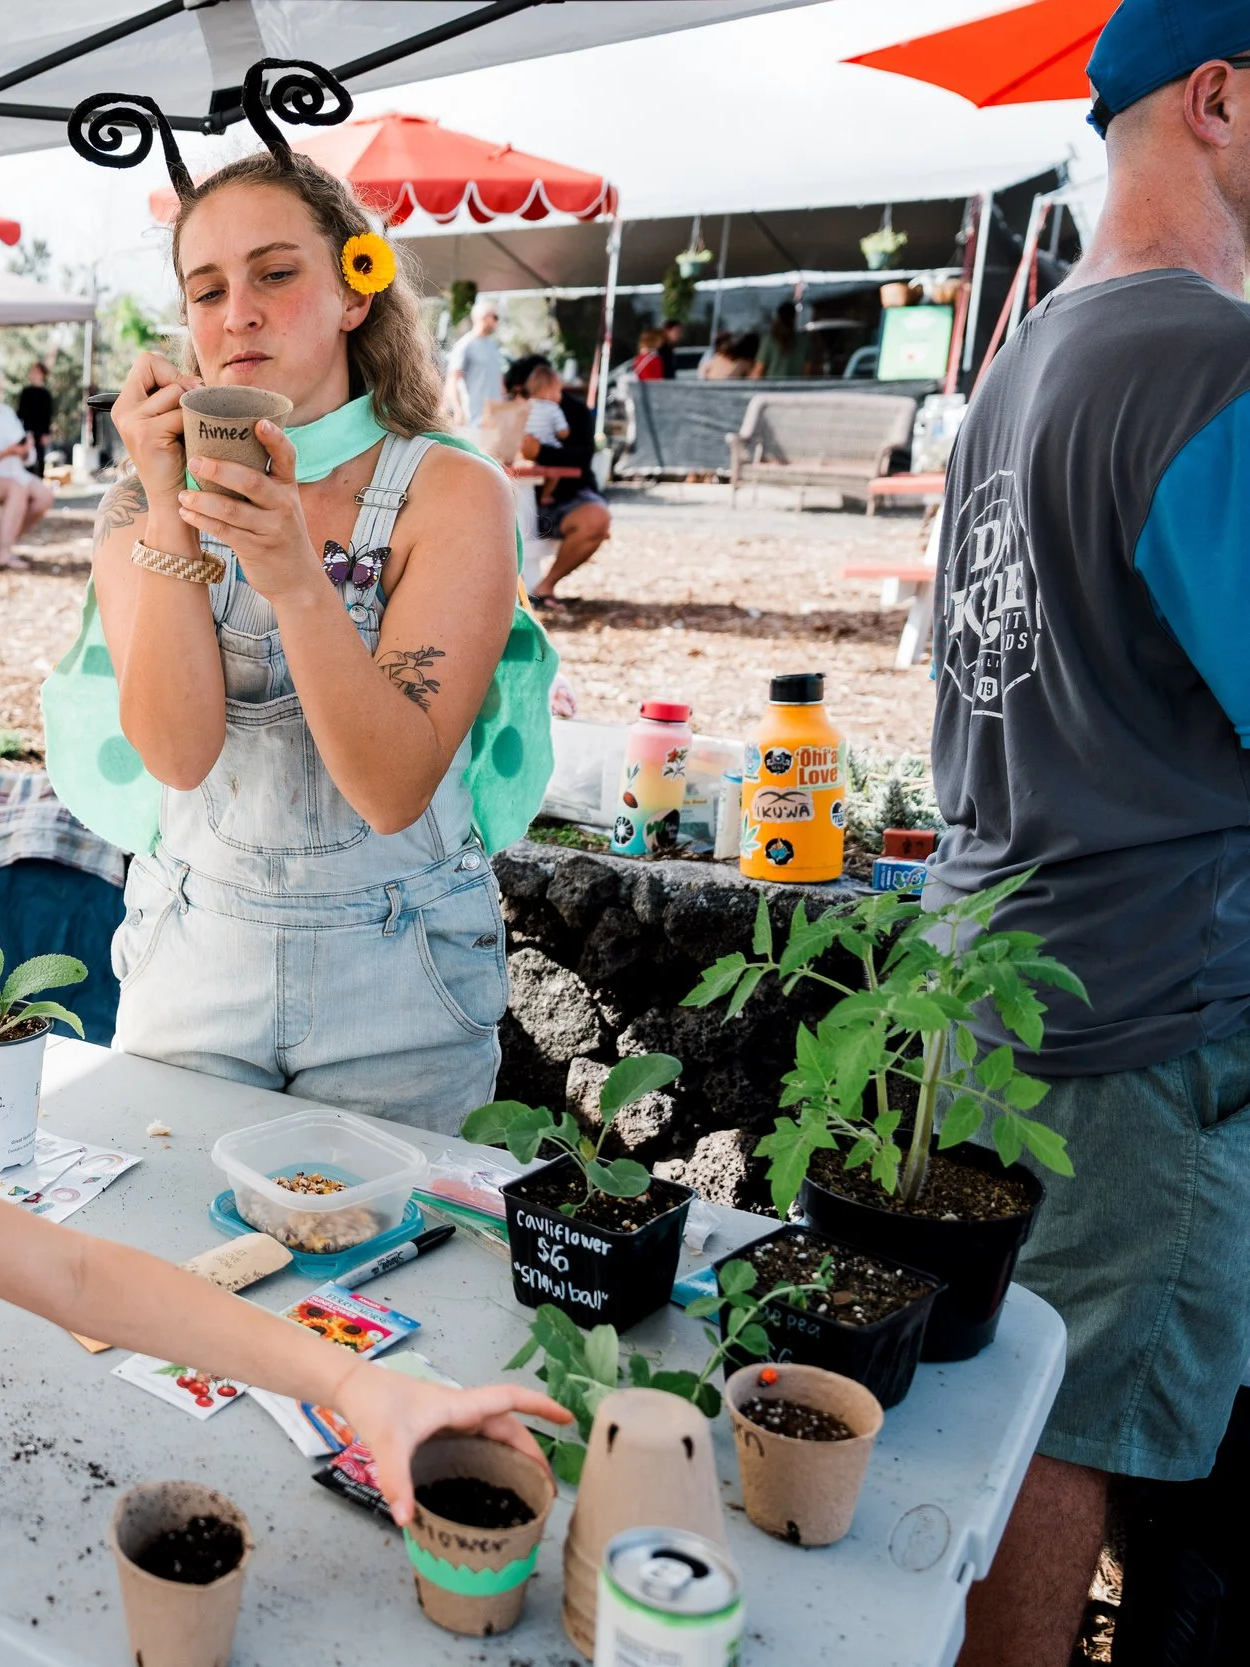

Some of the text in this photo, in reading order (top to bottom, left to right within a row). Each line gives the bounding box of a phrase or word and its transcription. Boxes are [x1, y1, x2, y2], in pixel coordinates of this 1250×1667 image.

[198, 420, 251, 441] Aimee
[799, 768, 838, 785] Love
[537, 1236, 570, 1273] $6
[787, 1313, 821, 1339] pea
